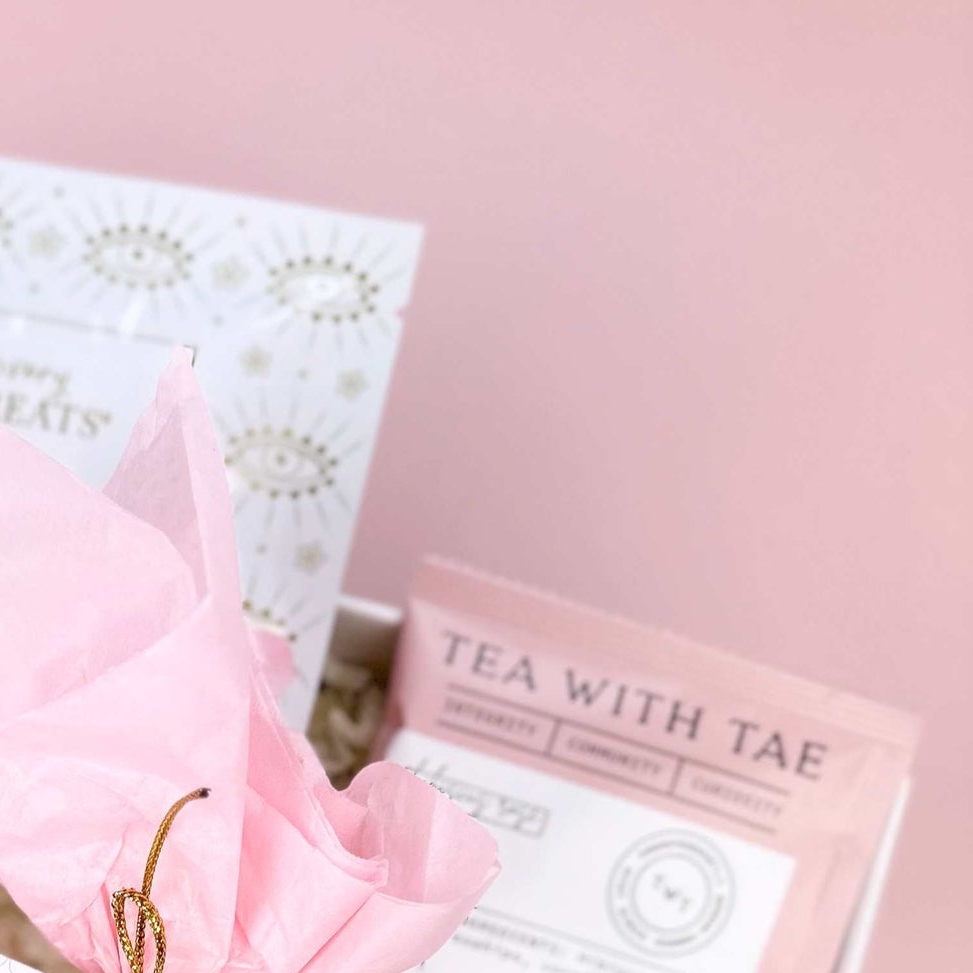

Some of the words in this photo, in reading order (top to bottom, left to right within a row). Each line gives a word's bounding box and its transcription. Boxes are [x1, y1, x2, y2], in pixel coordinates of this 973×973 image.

[439, 629, 537, 694] TEA
[564, 667, 705, 740] WITH
[727, 718, 830, 780] TAE
